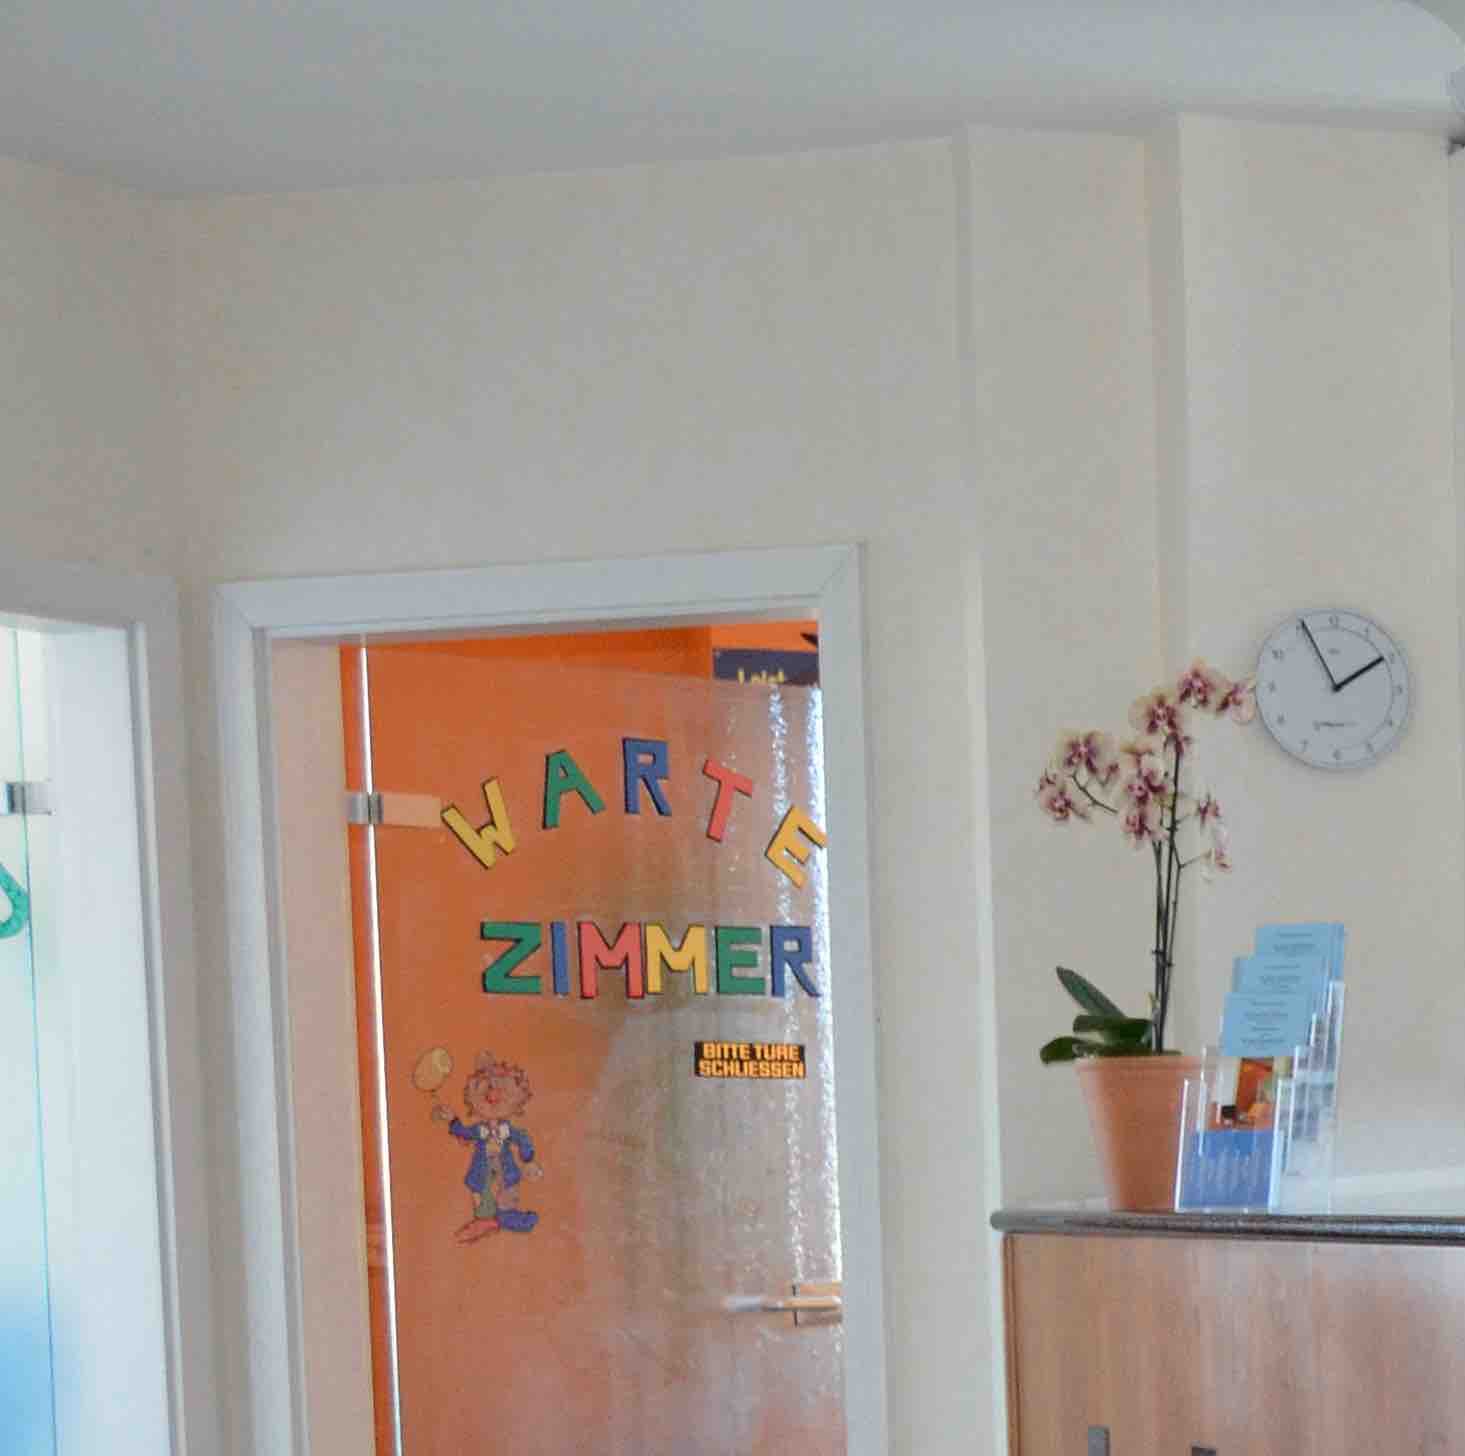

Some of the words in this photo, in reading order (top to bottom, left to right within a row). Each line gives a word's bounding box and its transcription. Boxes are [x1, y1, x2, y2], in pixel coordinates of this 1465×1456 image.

[441, 737, 827, 889] WARTE
[480, 921, 822, 998] ZIMMER
[699, 1059, 805, 1078] SCHLIESSEN
[703, 1042, 751, 1060] BITTE
